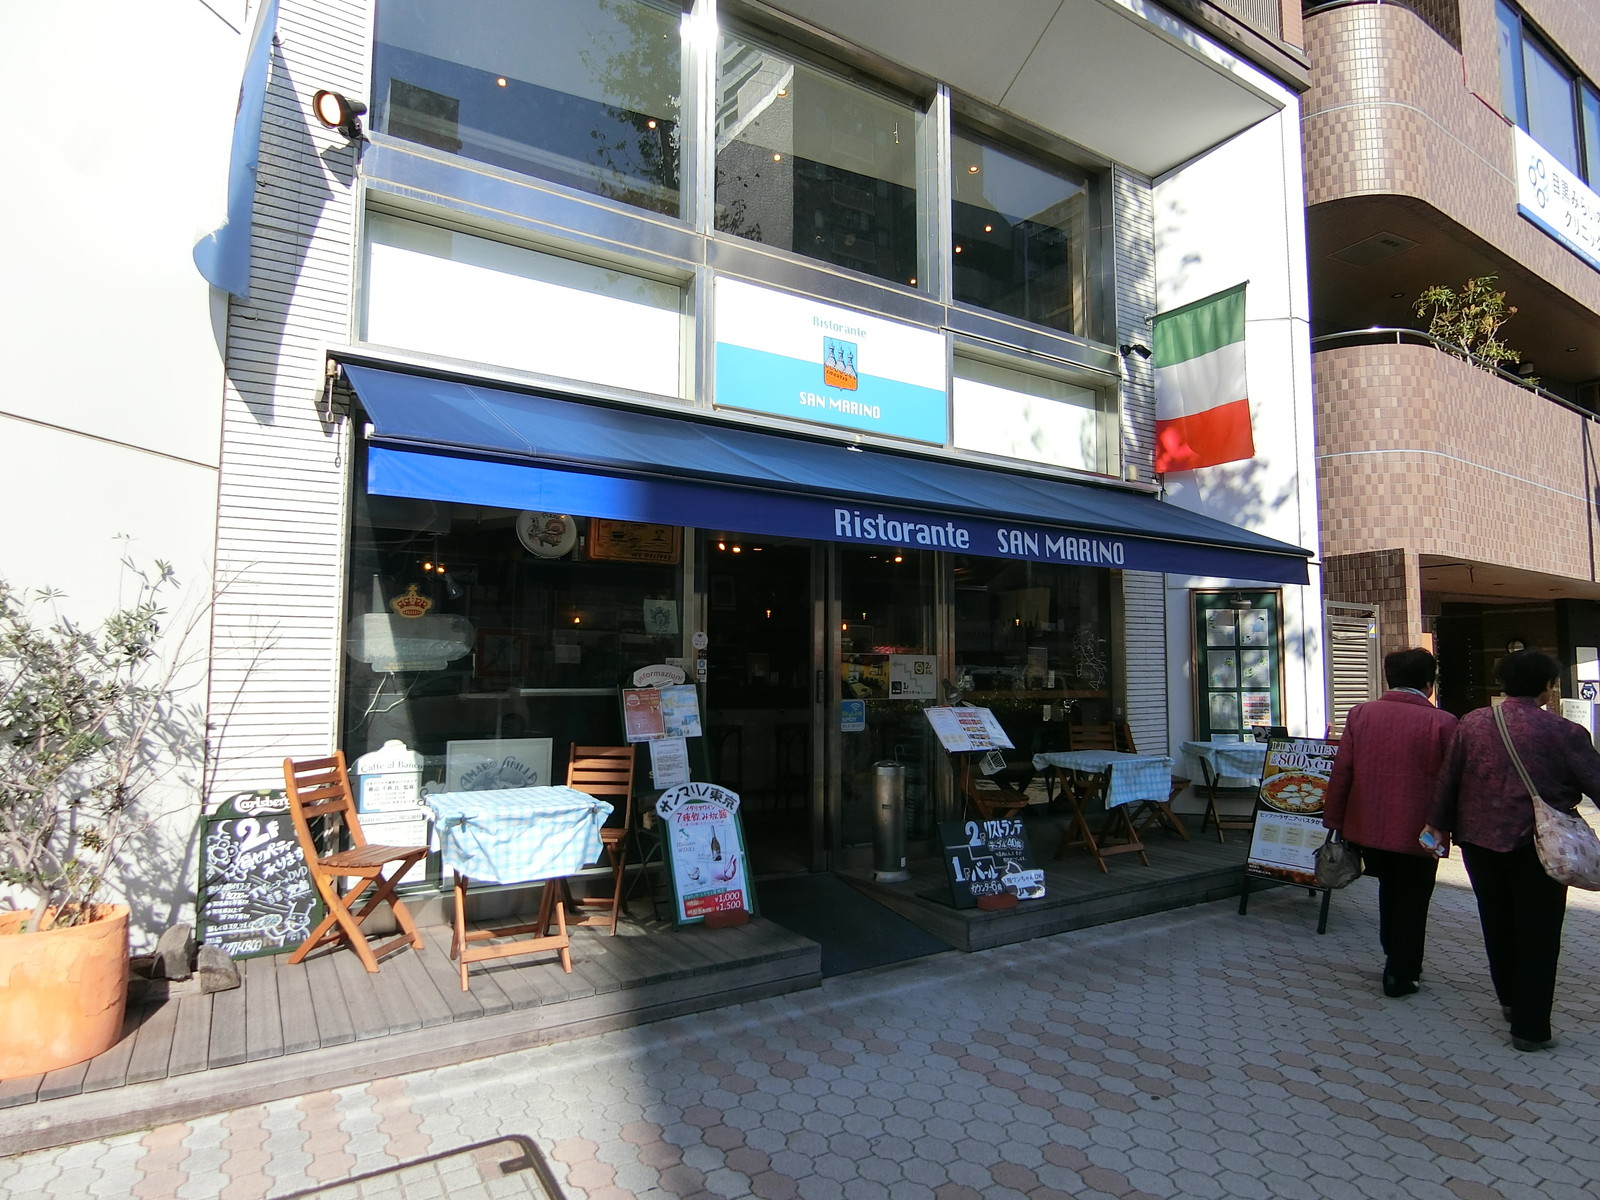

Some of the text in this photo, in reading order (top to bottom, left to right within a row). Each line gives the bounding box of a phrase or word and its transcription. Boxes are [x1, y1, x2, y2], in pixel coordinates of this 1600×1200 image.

[812, 316, 867, 339] Ristorante
[799, 391, 881, 419] SAN MARINO
[834, 508, 1125, 565] Ristorante SAN MARINO
[1271, 741, 1339, 756] LUNCH MEN
[398, 760, 425, 770] Banco
[660, 784, 738, 813] サンマリノ東京
[984, 820, 1022, 839] リストランテ
[971, 861, 999, 882] バール
